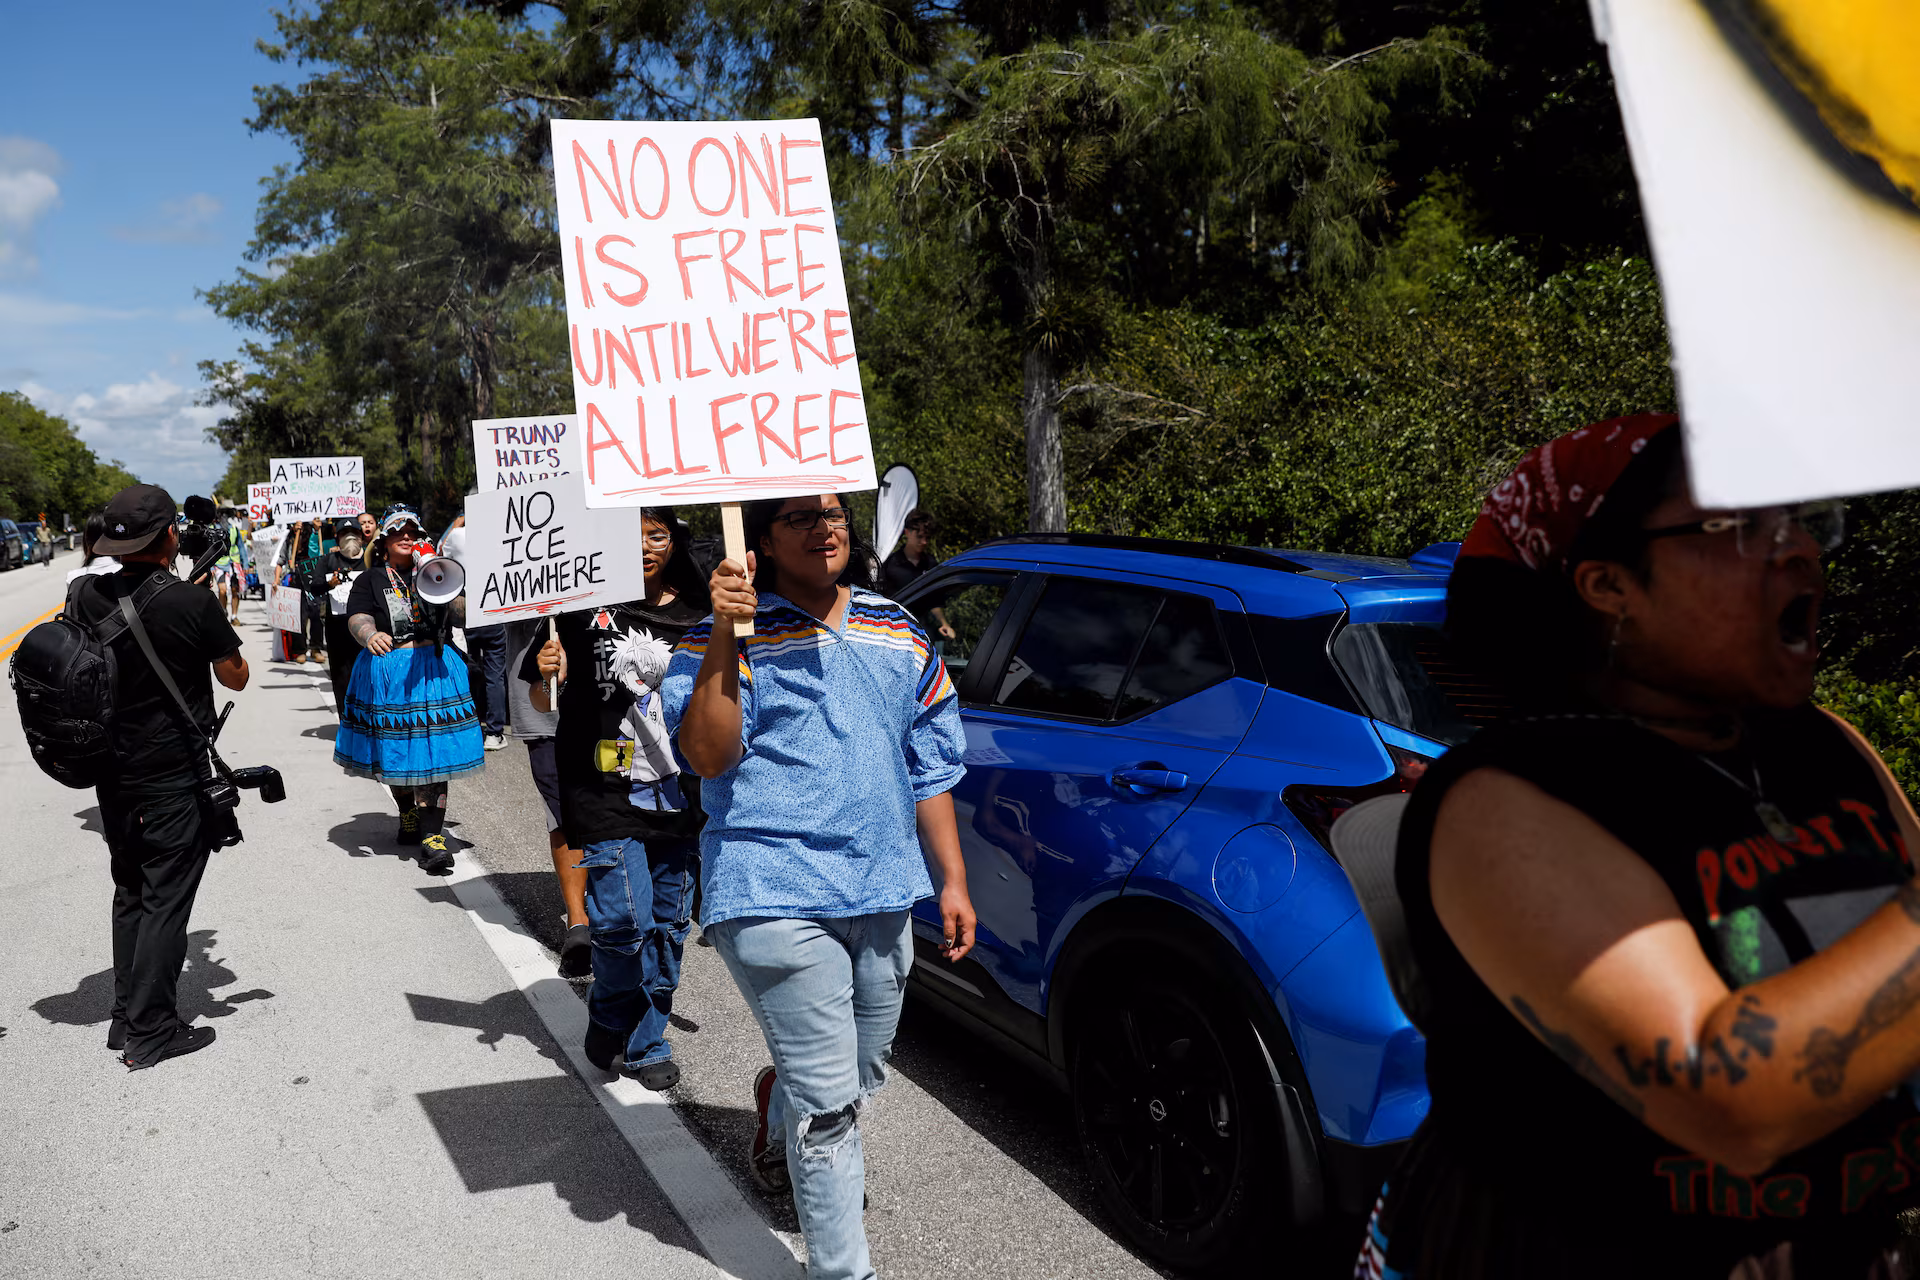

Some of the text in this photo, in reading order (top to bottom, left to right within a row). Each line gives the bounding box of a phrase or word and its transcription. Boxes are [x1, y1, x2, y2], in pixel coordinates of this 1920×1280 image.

[572, 131, 826, 223] NO ONE
[574, 223, 826, 309] IS FREE
[571, 306, 856, 389] UNTIL WE'RE
[487, 422, 567, 446] TRUMP
[495, 447, 560, 468] HATES
[586, 388, 865, 485] ALL FREE
[272, 485, 287, 495] DA
[348, 480, 362, 495] IS
[273, 460, 361, 482] A THREAT 2
[273, 503, 281, 515] A
[284, 499, 322, 514] THREAT
[324, 497, 337, 516] 2
[505, 490, 555, 534] NO
[502, 526, 565, 568] ICE
[479, 551, 606, 609] ANYWHERE
[593, 637, 617, 701] キルア
[1653, 1152, 1811, 1220] The
